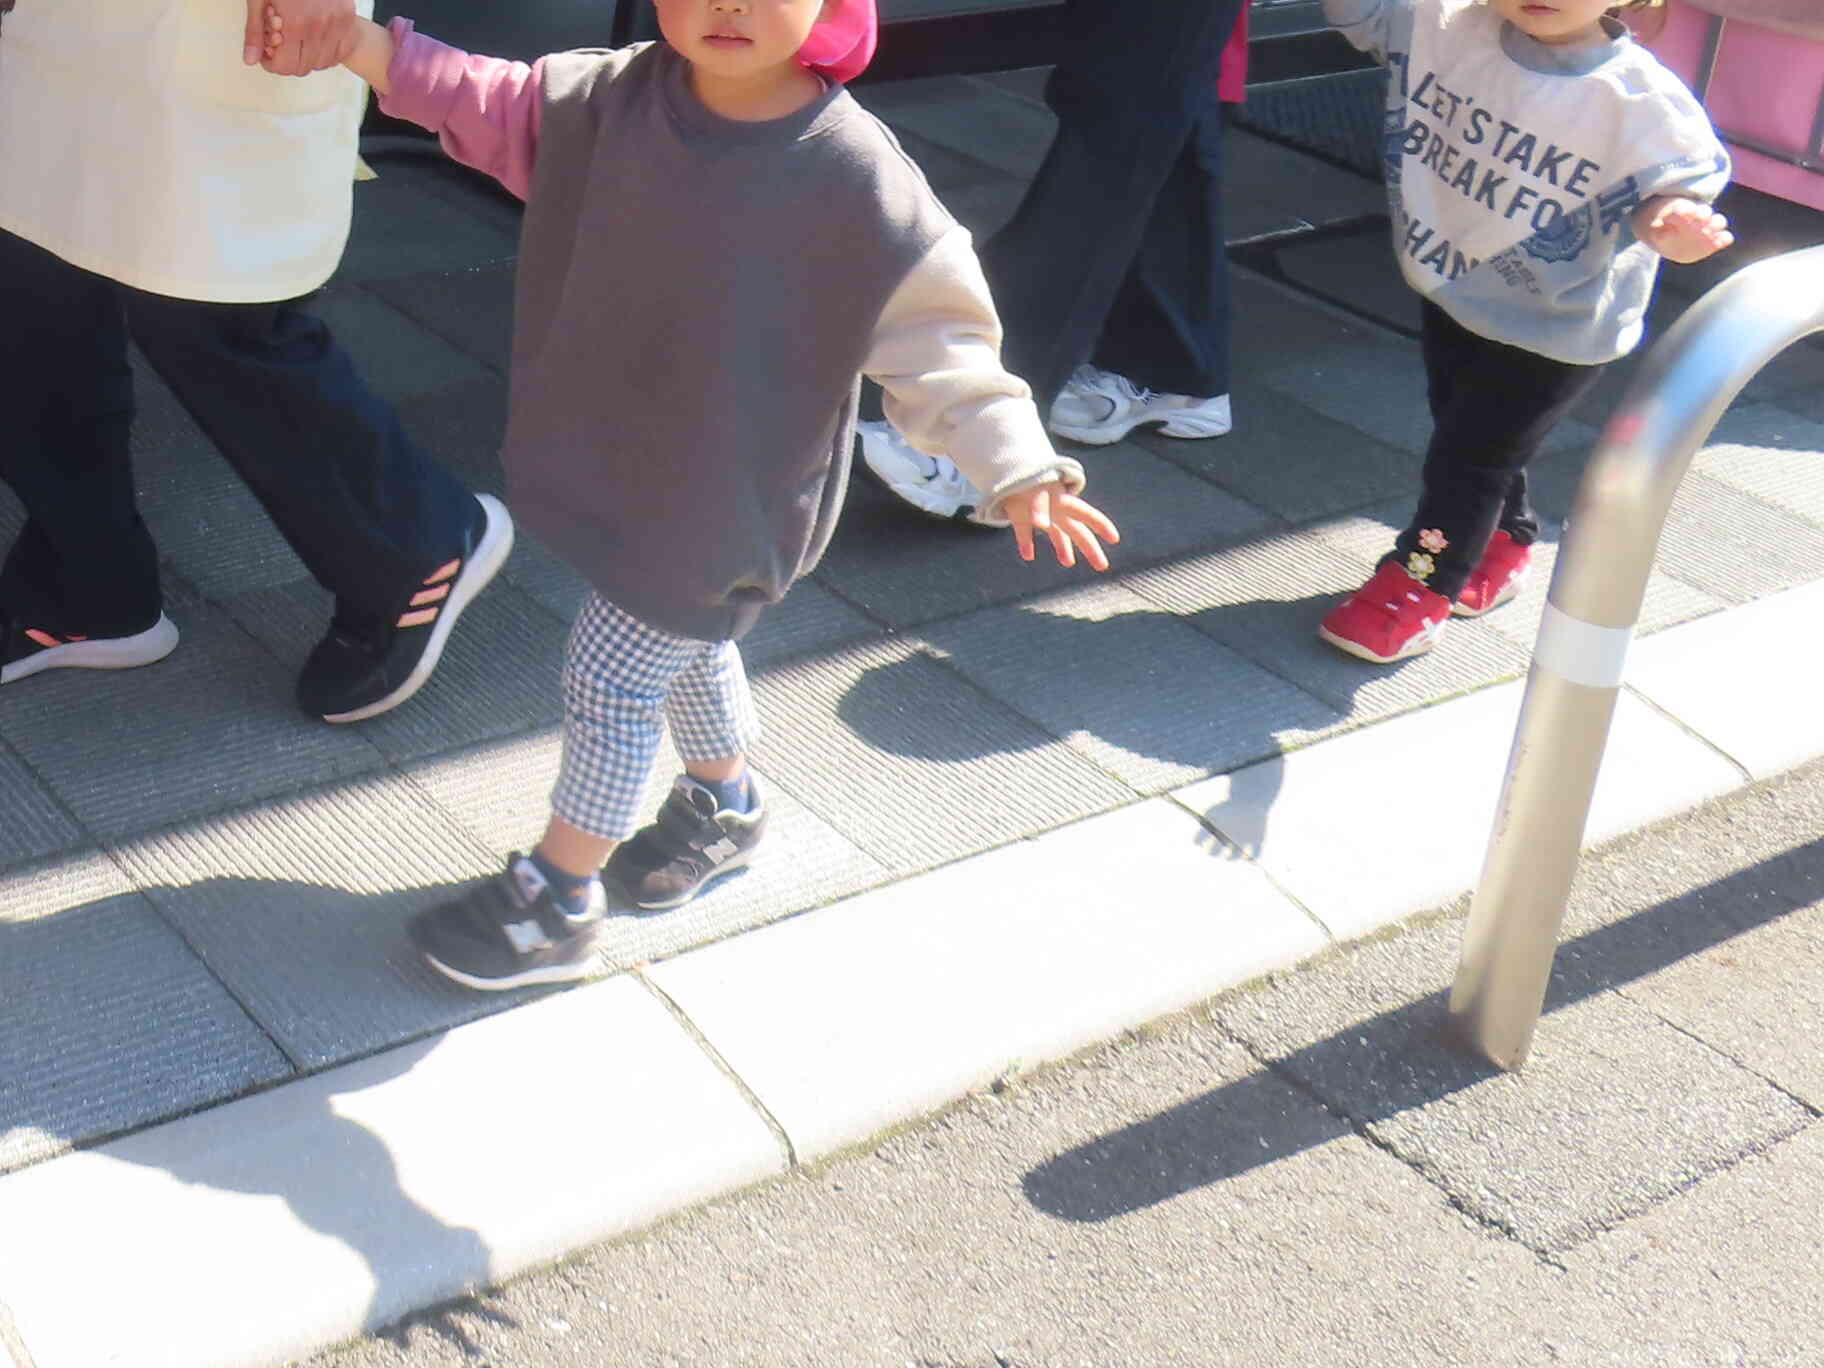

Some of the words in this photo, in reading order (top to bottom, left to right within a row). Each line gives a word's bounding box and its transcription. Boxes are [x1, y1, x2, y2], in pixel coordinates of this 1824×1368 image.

[1402, 119, 1508, 211] BREAK
[1410, 71, 1493, 145] LET'S
[1492, 120, 1600, 198] TAKE
[1403, 212, 1479, 281] HAN
